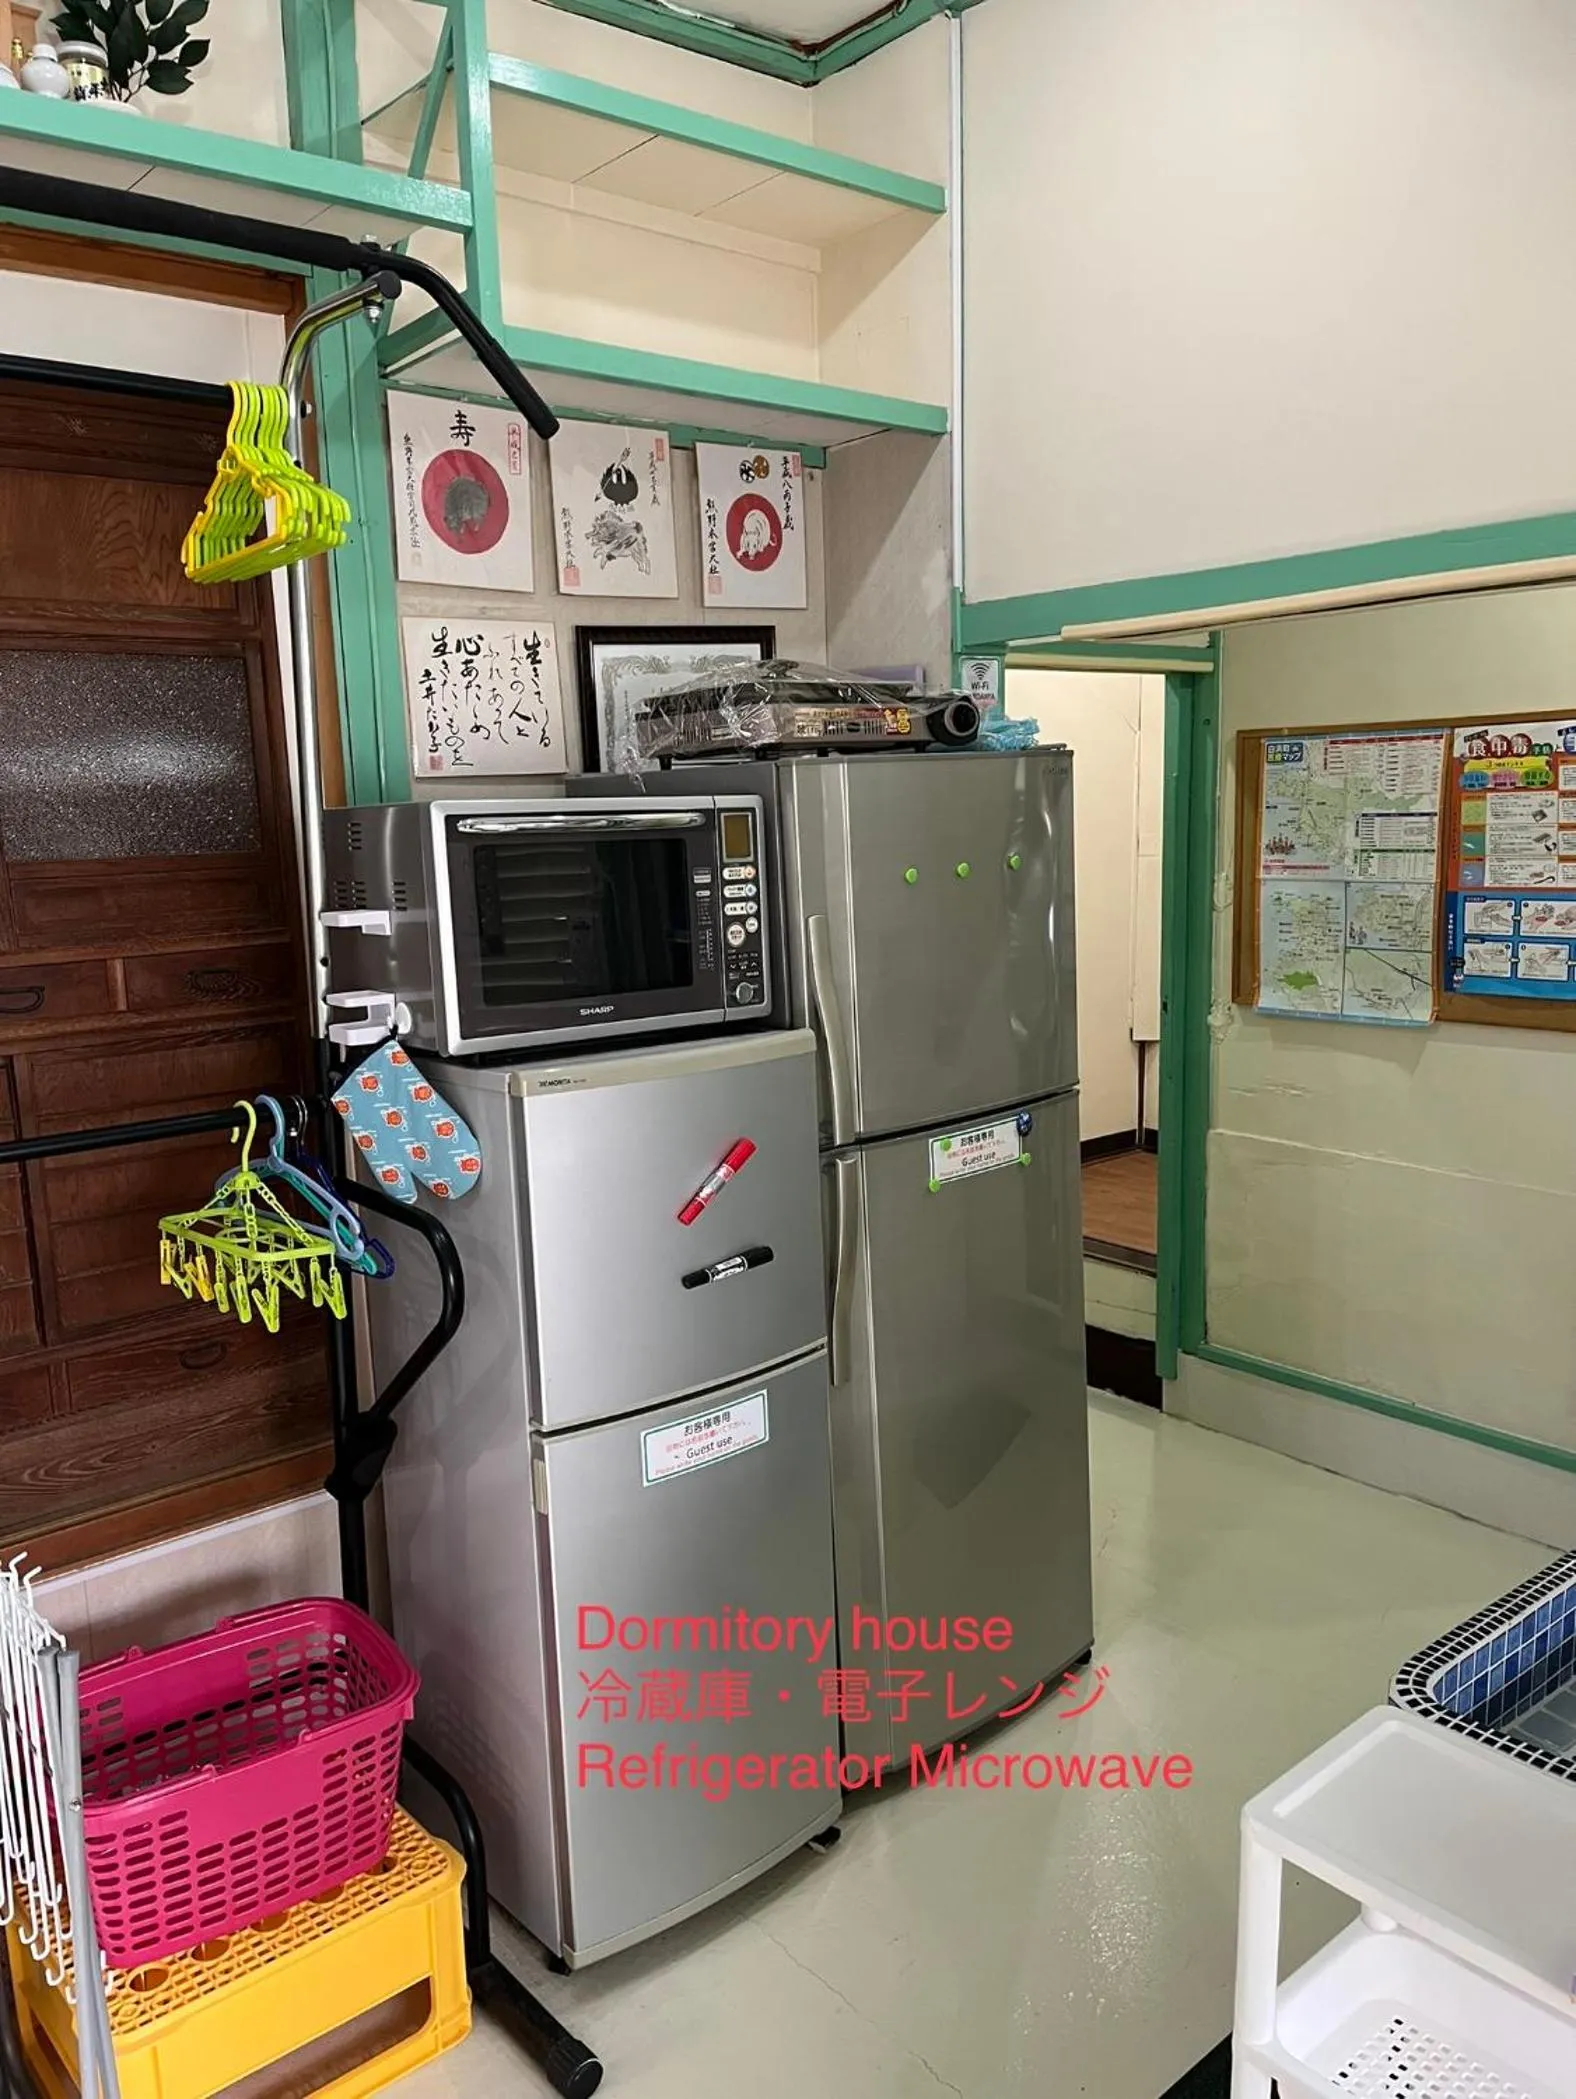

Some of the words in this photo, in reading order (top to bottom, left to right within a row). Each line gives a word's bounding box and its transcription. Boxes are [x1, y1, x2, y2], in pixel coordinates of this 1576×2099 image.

[450, 410, 476, 447] 寿
[705, 498, 720, 575] 熊野本宮大社
[971, 681, 989, 691] Wi-Fi
[580, 1005, 614, 1016] SHARP
[962, 1154, 982, 1167] Guest
[984, 1151, 996, 1161] use
[684, 1411, 731, 1436] お客様専用
[687, 1442, 715, 1459] Guest
[716, 1436, 733, 1448] use
